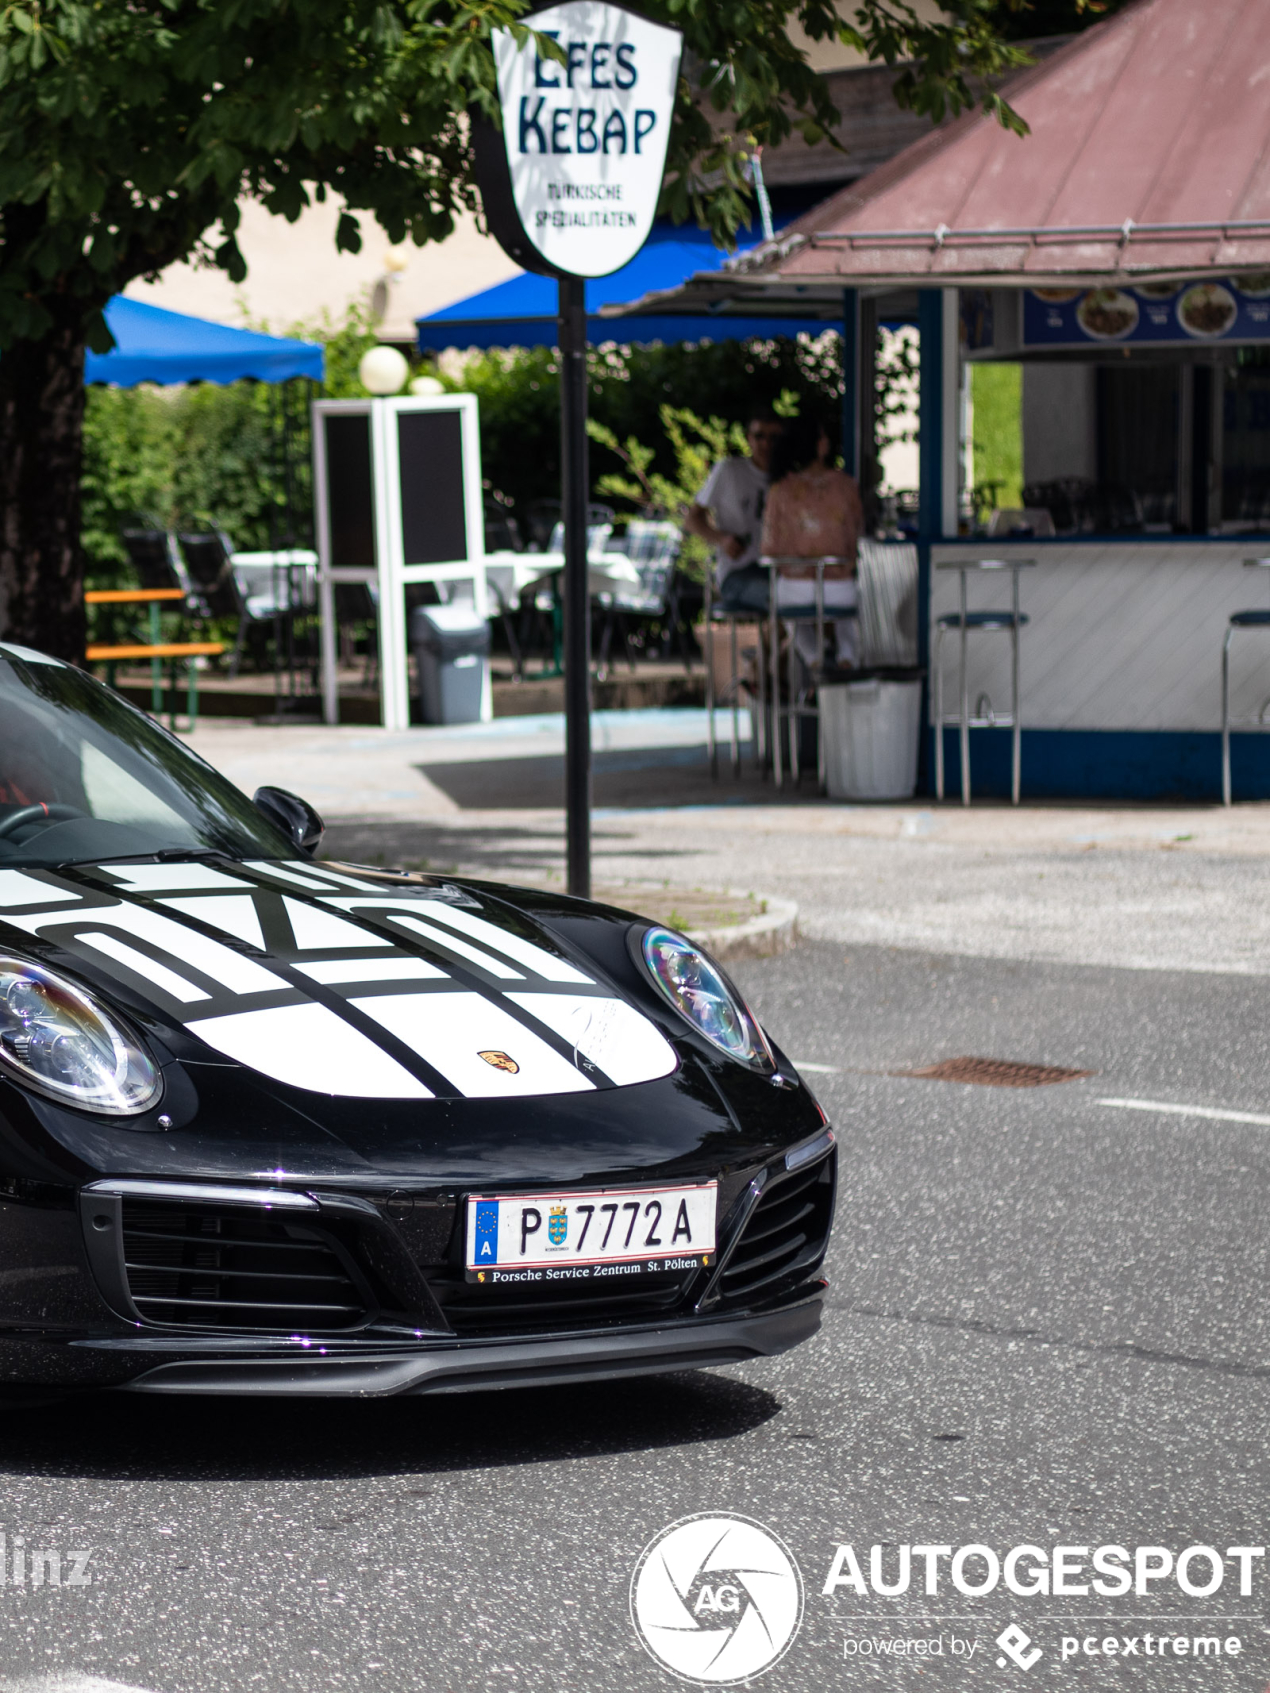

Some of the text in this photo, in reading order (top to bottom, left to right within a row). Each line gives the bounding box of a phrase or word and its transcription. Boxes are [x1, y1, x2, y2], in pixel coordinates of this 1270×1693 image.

[534, 30, 638, 90] EFES
[518, 96, 657, 155] KEBAP
[480, 1241, 492, 1255] A
[519, 1207, 542, 1255] P
[492, 1257, 697, 1283] Porsche Service Zentrum St. Pölten
